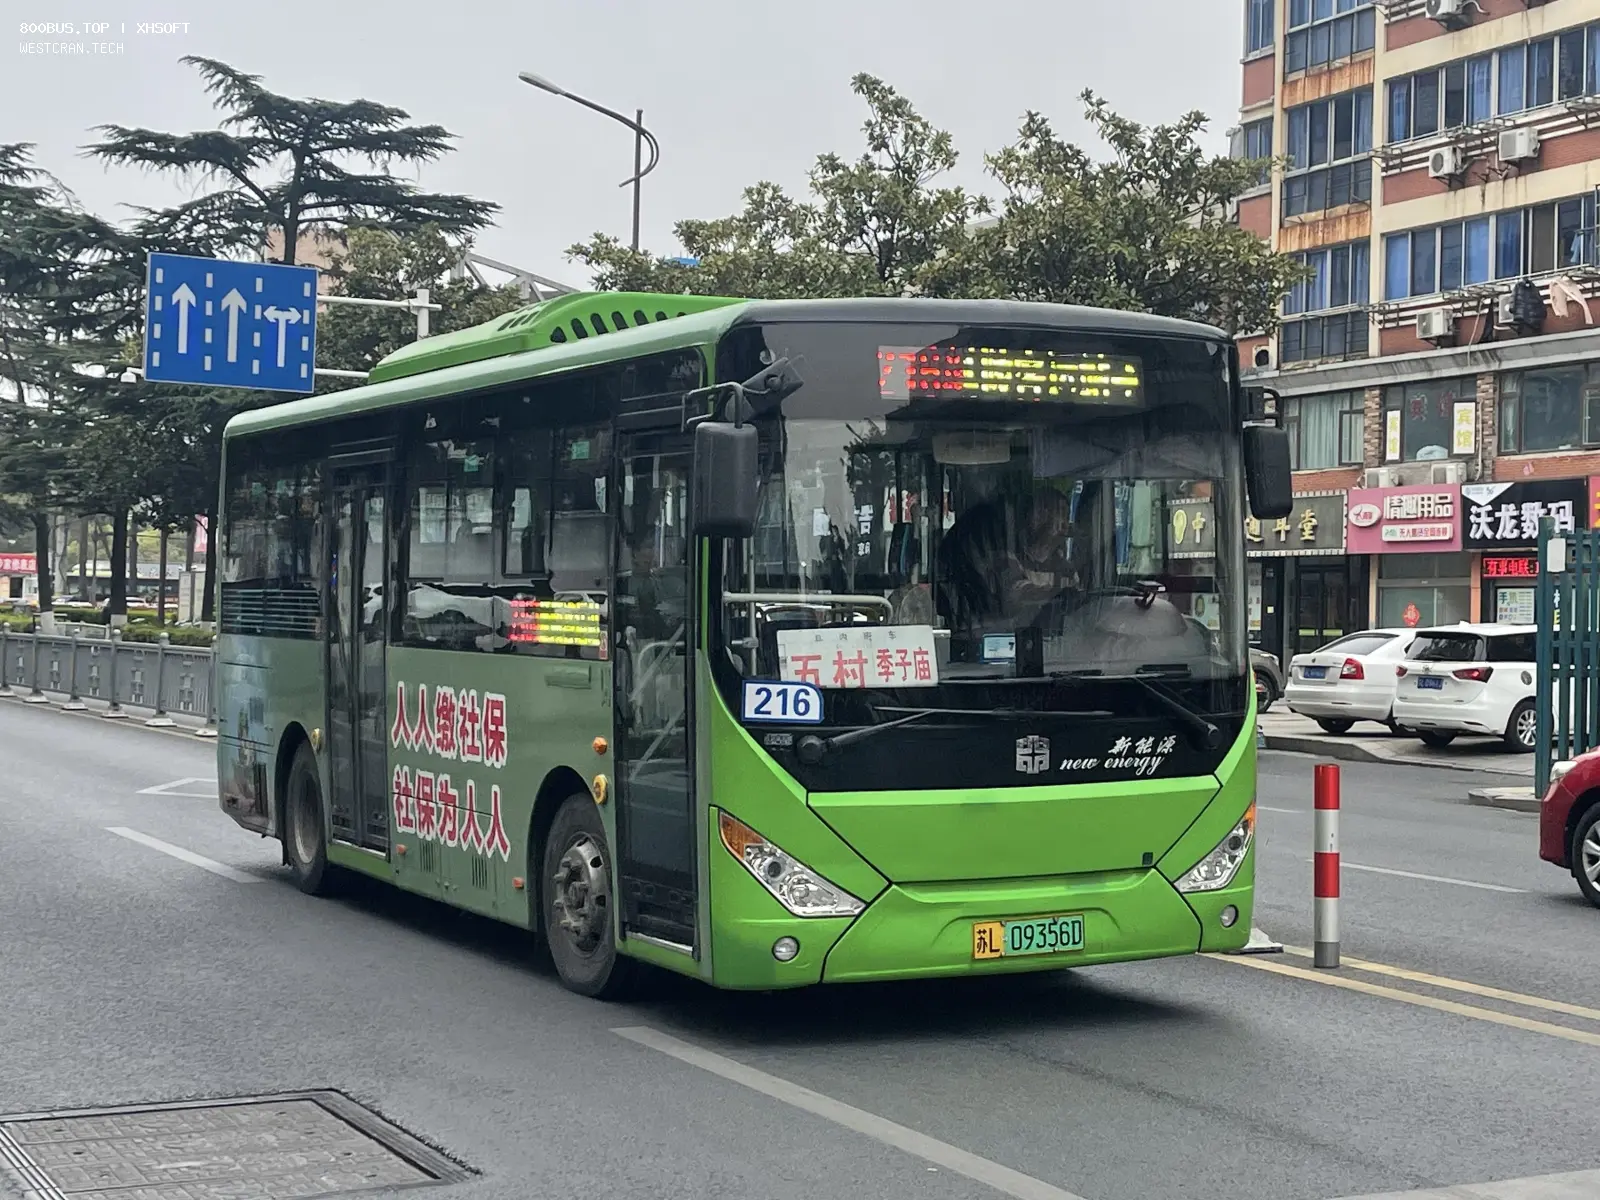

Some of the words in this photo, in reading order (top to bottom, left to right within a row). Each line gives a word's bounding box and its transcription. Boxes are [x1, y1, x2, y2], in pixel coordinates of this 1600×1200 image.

[1469, 500, 1576, 540] 沃龙数码
[876, 646, 932, 683] 季子庙
[754, 686, 811, 716] 216
[391, 681, 508, 769] 人人缴社保
[1108, 734, 1177, 757] 新能源
[1059, 757, 1100, 770] new
[1104, 753, 1166, 776] energy
[392, 764, 511, 862] 社保为人人
[1011, 920, 1082, 951] 09356D
